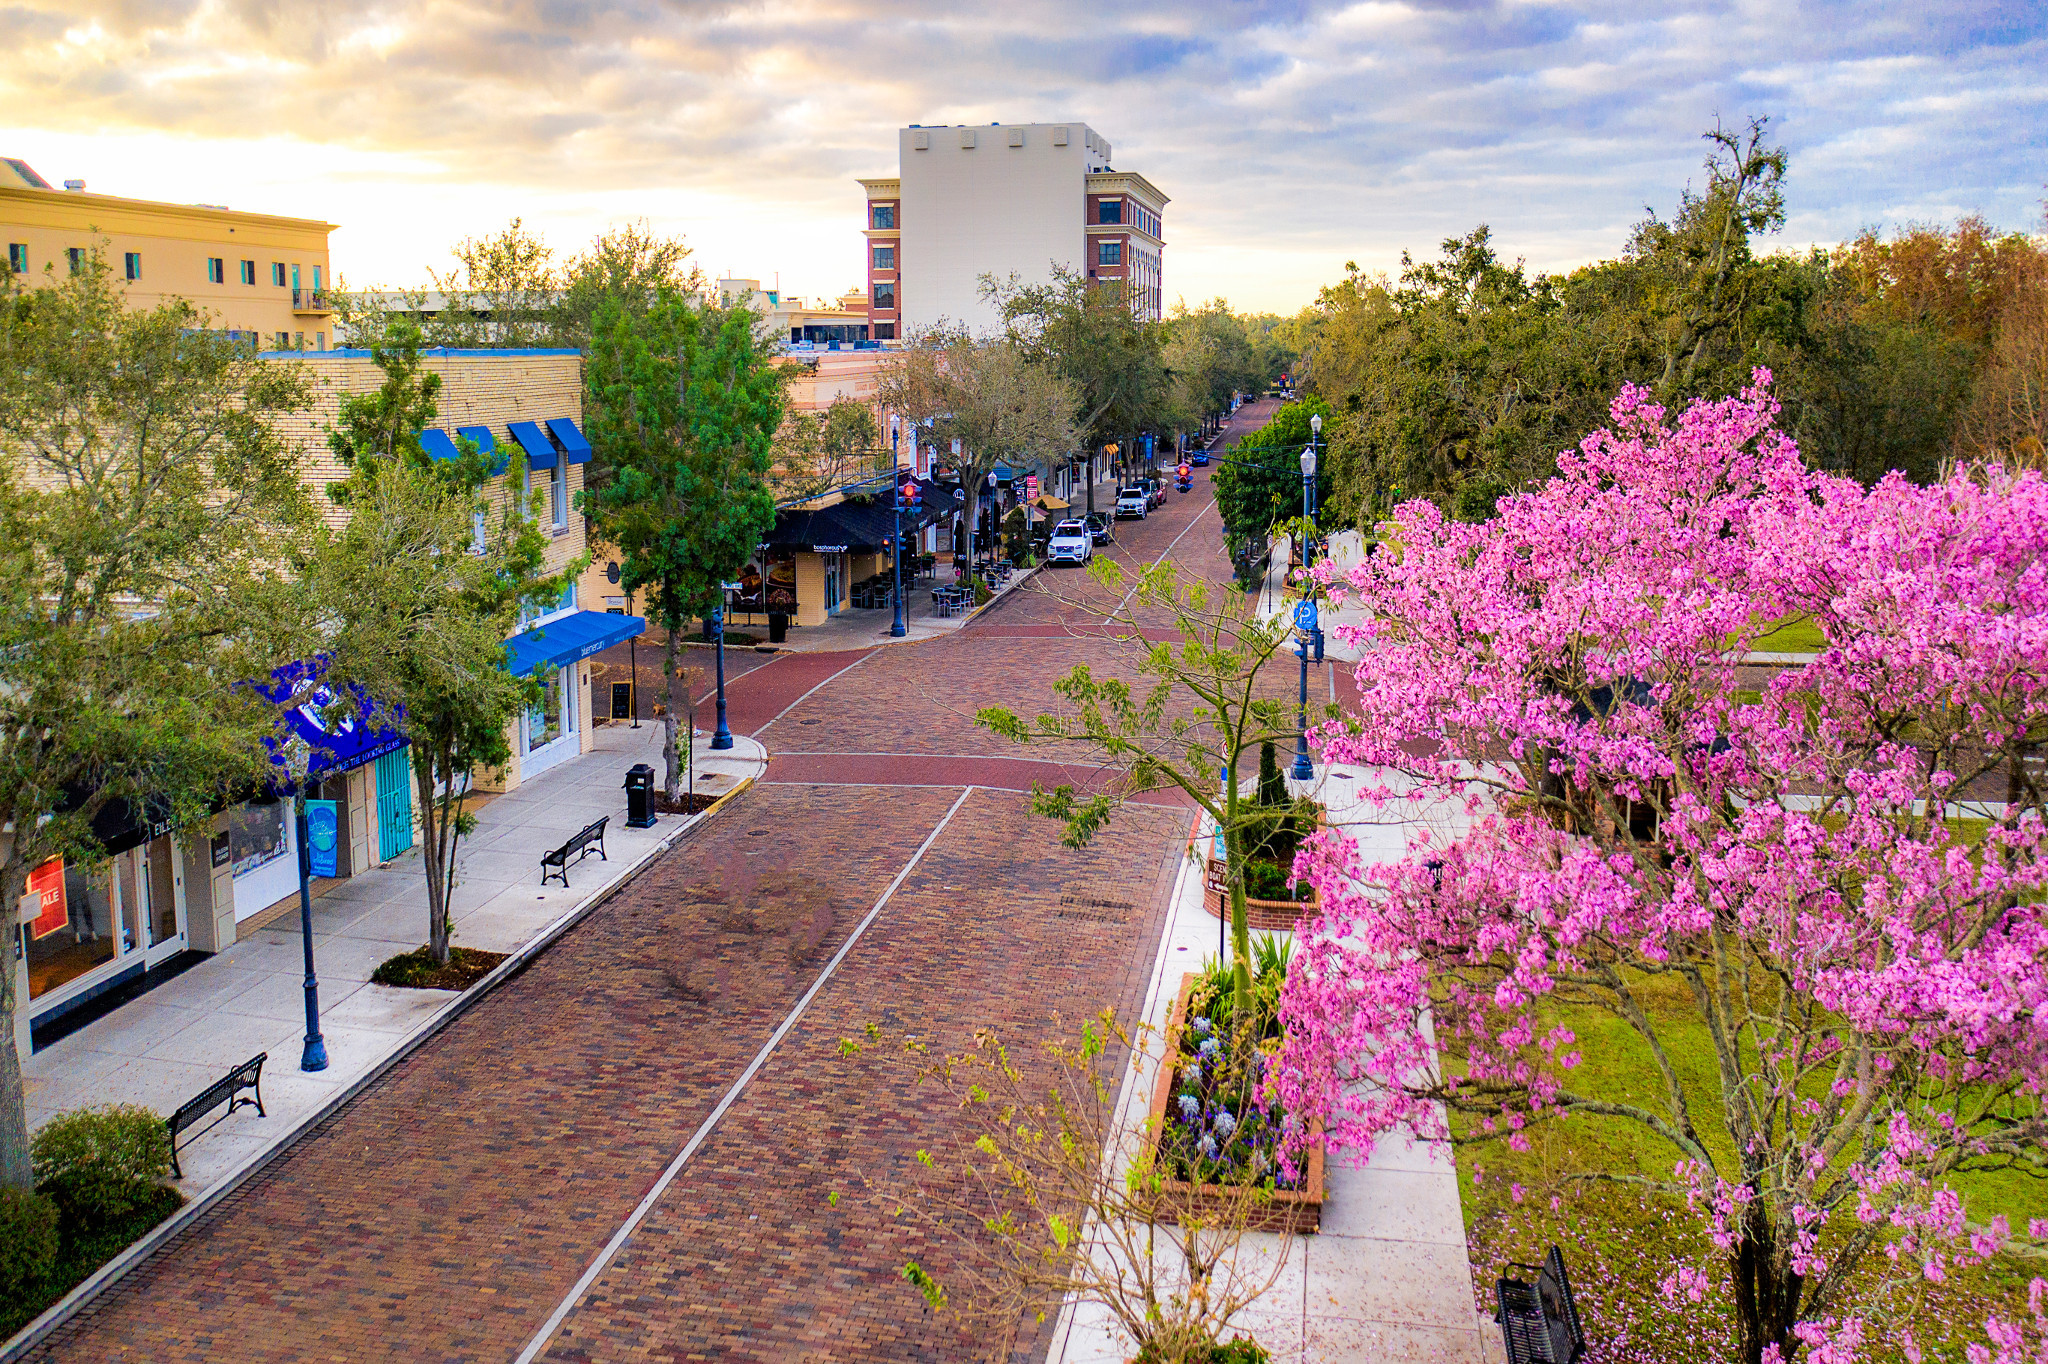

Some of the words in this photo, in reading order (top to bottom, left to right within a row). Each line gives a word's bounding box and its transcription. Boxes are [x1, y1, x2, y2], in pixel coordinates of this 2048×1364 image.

[1299, 606, 1311, 624] P
[581, 640, 605, 657] bluemercury
[350, 755, 361, 767] THE
[362, 744, 385, 762] LOOKING
[385, 738, 401, 752] GLASS
[1209, 870, 1221, 882] BOAT
[41, 890, 60, 908] ALE
